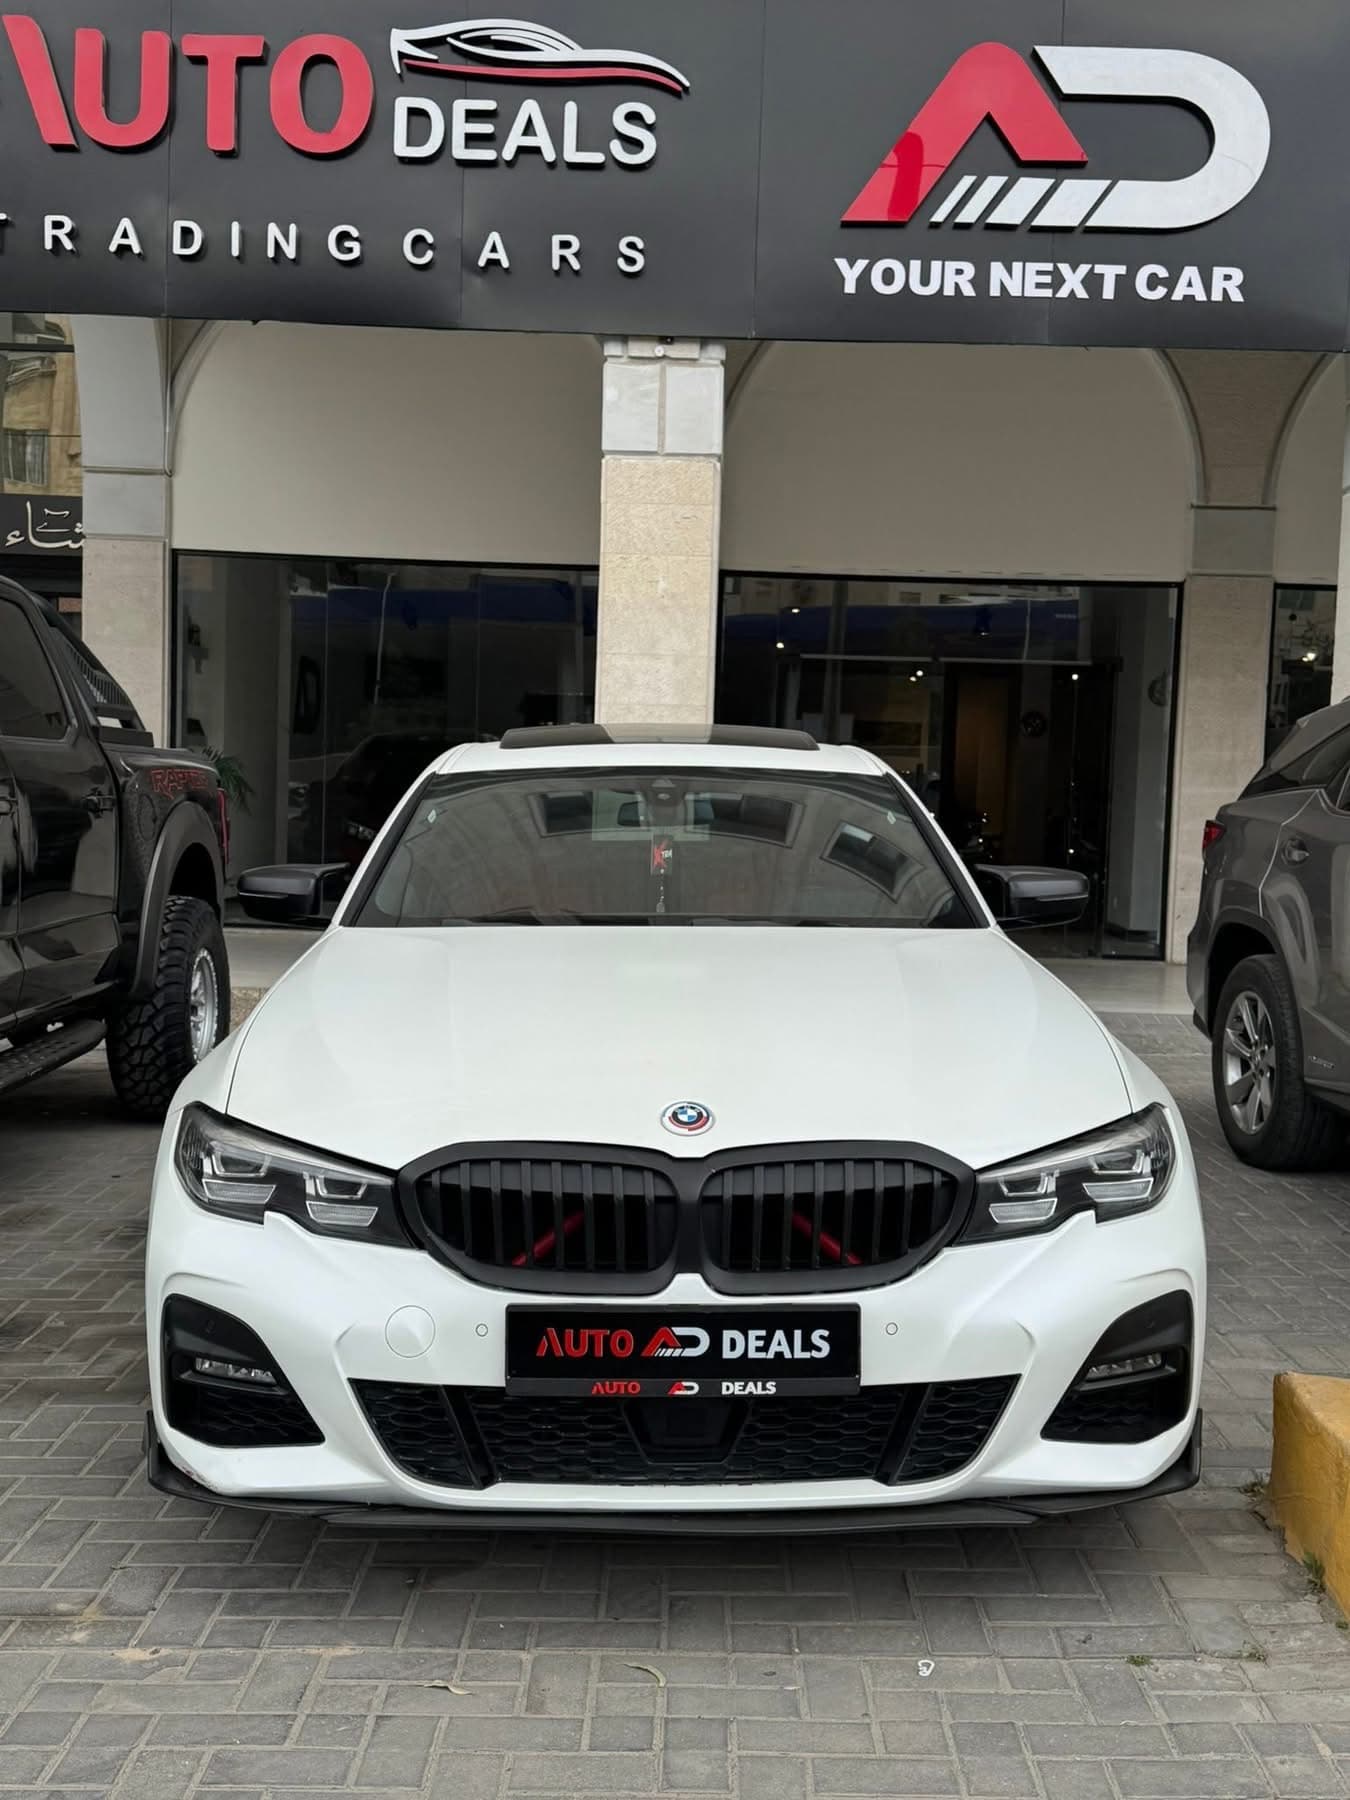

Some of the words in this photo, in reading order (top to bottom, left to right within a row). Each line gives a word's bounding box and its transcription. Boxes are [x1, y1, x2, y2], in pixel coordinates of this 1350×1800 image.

[393, 96, 657, 165] DEALS
[402, 228, 645, 273] CARS
[833, 257, 977, 297] YOUR
[989, 261, 1127, 300] NEXT
[1134, 263, 1245, 303] CAR
[535, 1327, 634, 1358] AUTO
[721, 1329, 831, 1359] DEALS
[590, 1380, 641, 1396] AUTO
[720, 1380, 777, 1396] DEALS
